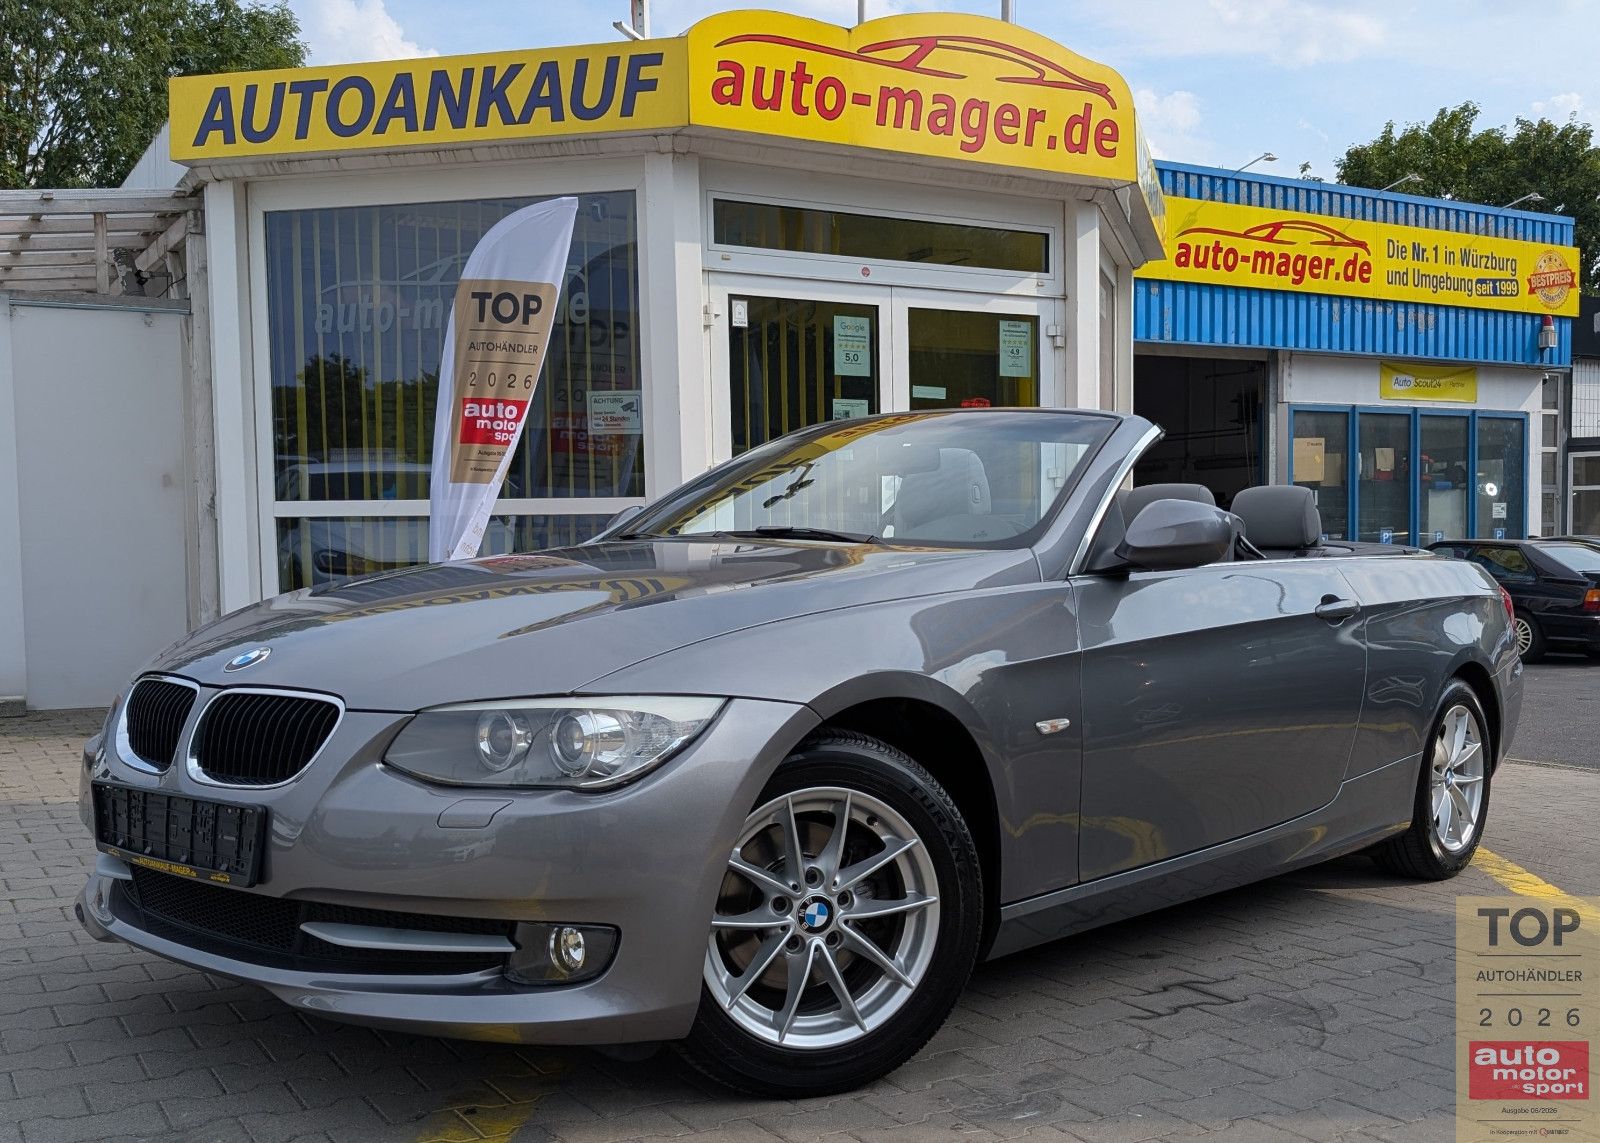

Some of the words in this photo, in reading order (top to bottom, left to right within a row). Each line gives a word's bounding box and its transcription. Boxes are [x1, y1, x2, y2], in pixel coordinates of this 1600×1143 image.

[192, 52, 664, 147] AUTOANKAUF
[711, 59, 1120, 158] auto-mager.de
[1174, 240, 1373, 286] auto-mager.de
[1386, 239, 1407, 260] Die
[1412, 242, 1429, 263] Nr.
[1432, 244, 1439, 264] 1
[1444, 246, 1456, 265] in
[1460, 248, 1517, 277] Würzburg
[1386, 268, 1409, 287] und
[1412, 269, 1474, 297] Umgebung
[1475, 281, 1493, 295] seit
[1496, 281, 1518, 295] 1999
[1531, 270, 1573, 288] BESTPREIS
[471, 292, 543, 325] TOP
[840, 321, 865, 332] Google
[468, 341, 539, 354] AUTOHÄNDLER
[845, 353, 859, 363] 5,0
[469, 372, 533, 389] 2026
[464, 402, 518, 419] auto
[494, 432, 517, 442] spo
[1383, 532, 1389, 543] P
[1496, 530, 1502, 540] P
